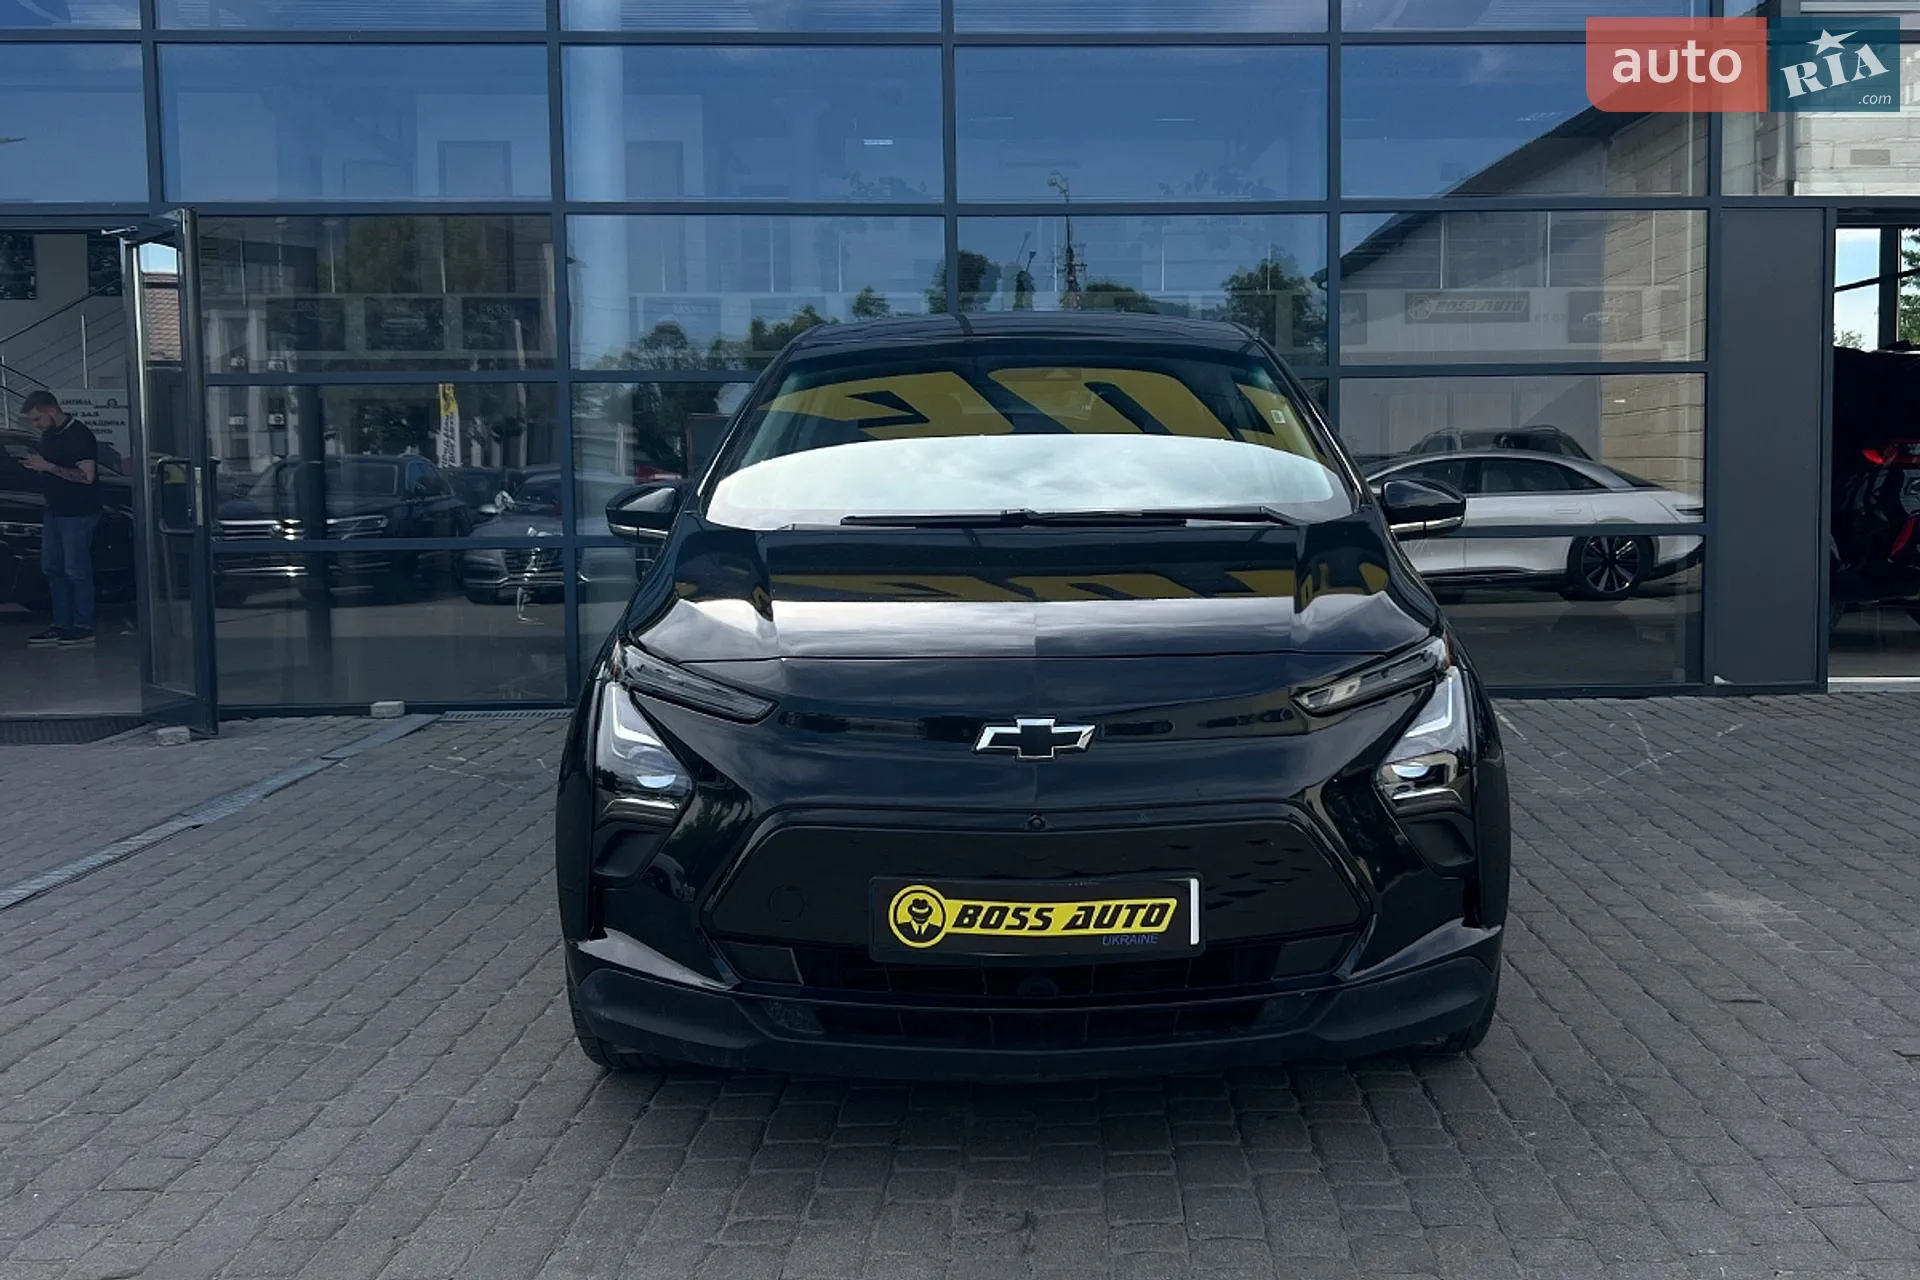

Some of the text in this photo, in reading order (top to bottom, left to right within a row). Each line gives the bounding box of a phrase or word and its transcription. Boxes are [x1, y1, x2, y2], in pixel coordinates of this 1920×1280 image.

[951, 902, 1171, 931] BOSS AUTO
[1102, 934, 1159, 946] UKRAINE
